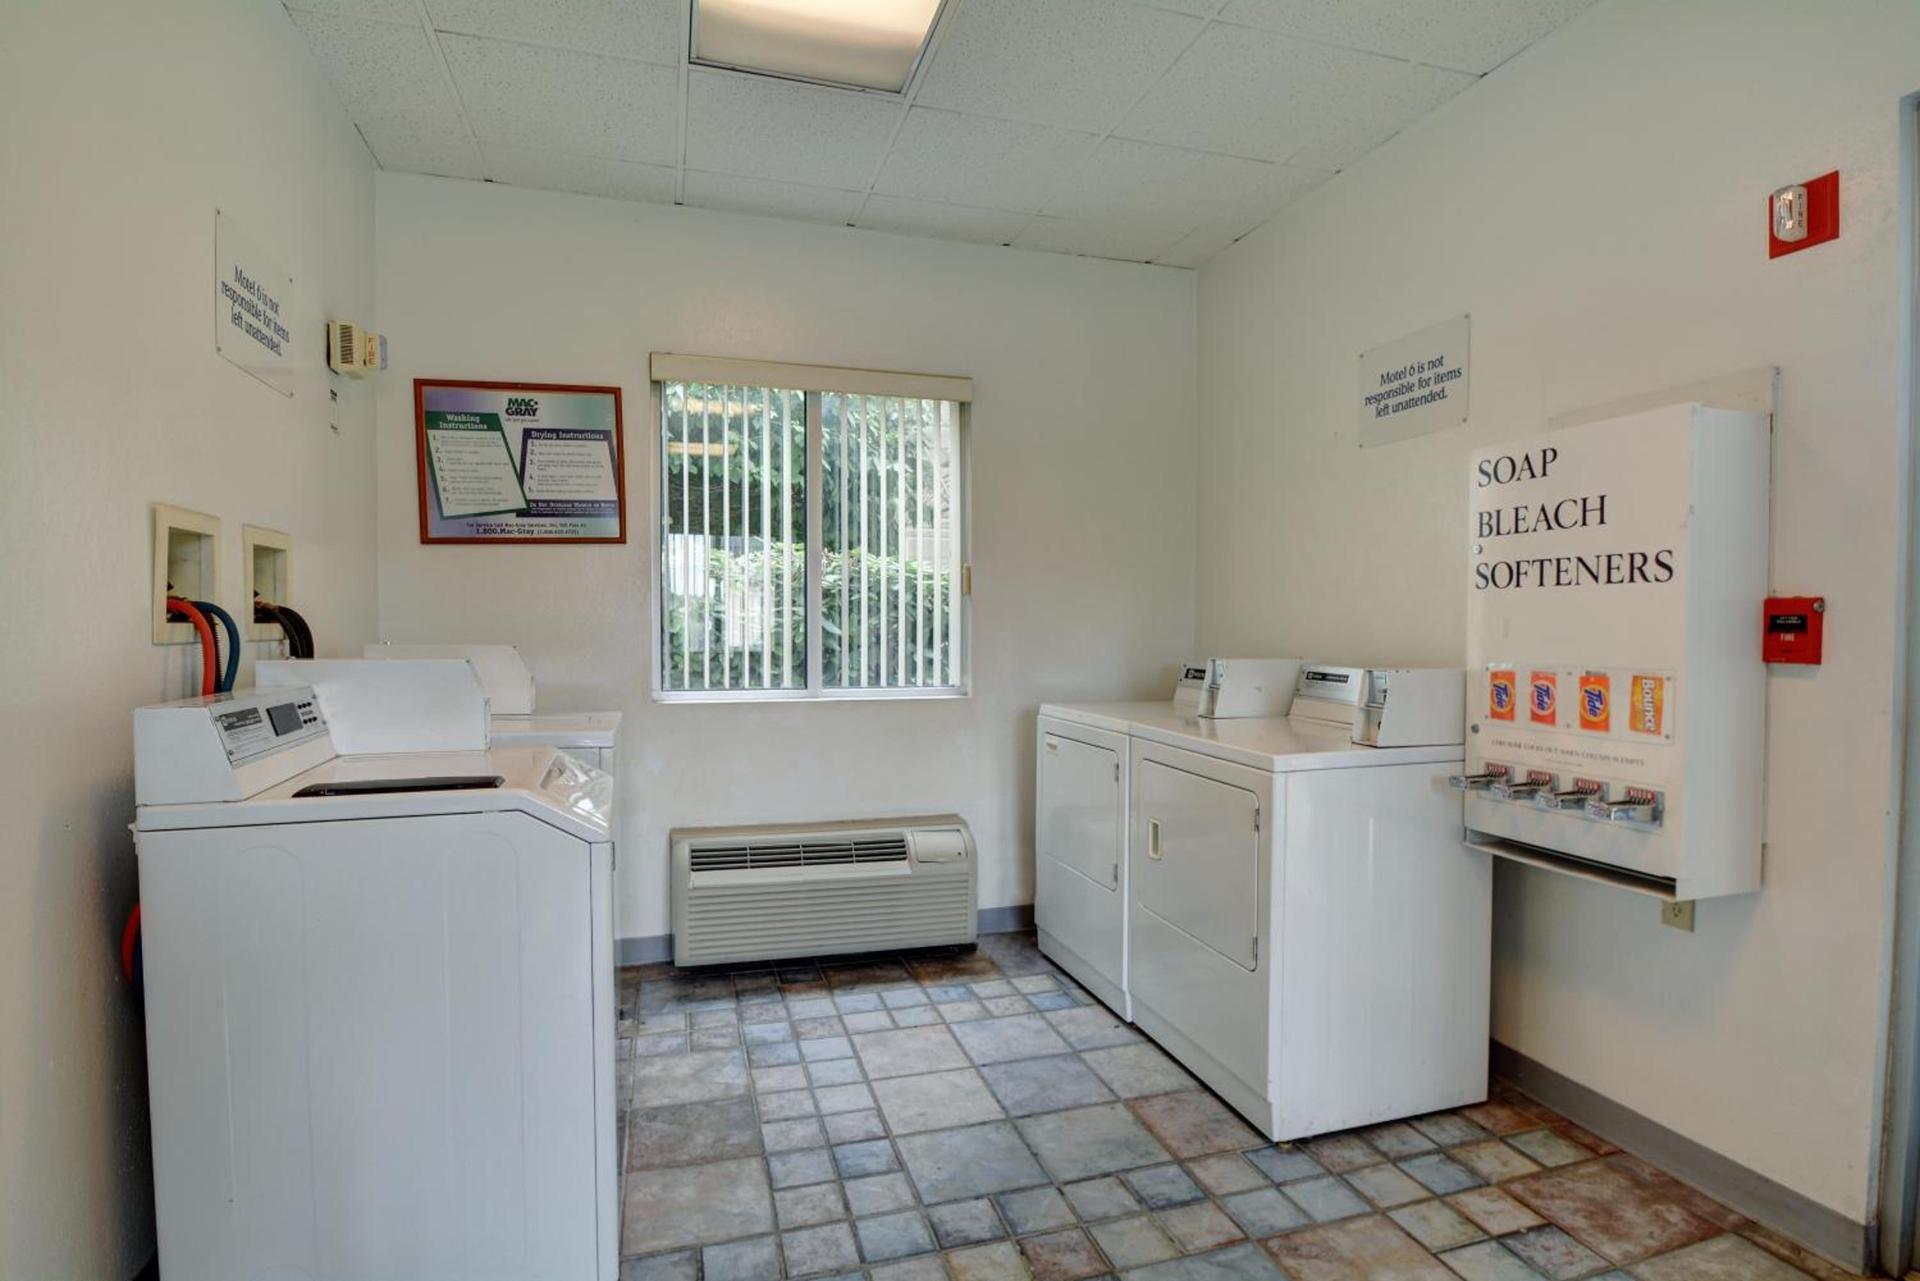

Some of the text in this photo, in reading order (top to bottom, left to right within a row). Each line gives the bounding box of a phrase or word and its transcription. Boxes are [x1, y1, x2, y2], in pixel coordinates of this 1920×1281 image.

[234, 264, 280, 317] Motel 6 is not
[221, 280, 290, 344] responsible for items
[231, 304, 283, 357] left unattended.
[1364, 367, 1463, 407] responsible for items
[1380, 355, 1445, 387] Motel 6 is not
[446, 413, 481, 423] Washing
[505, 407, 538, 417] GRAY
[1375, 386, 1448, 419] left unattended.
[439, 421, 488, 430] Instructions
[531, 430, 605, 440] Drying Instructions
[1478, 448, 1558, 487] SOAP
[476, 527, 535, 536] 1.800.Mac-Gray
[1478, 495, 1607, 538] BLEACH
[1475, 550, 1674, 590] SOFTENERS
[1493, 683, 1508, 709] Tide
[1534, 684, 1551, 712] Tide
[1584, 689, 1603, 718] Tide
